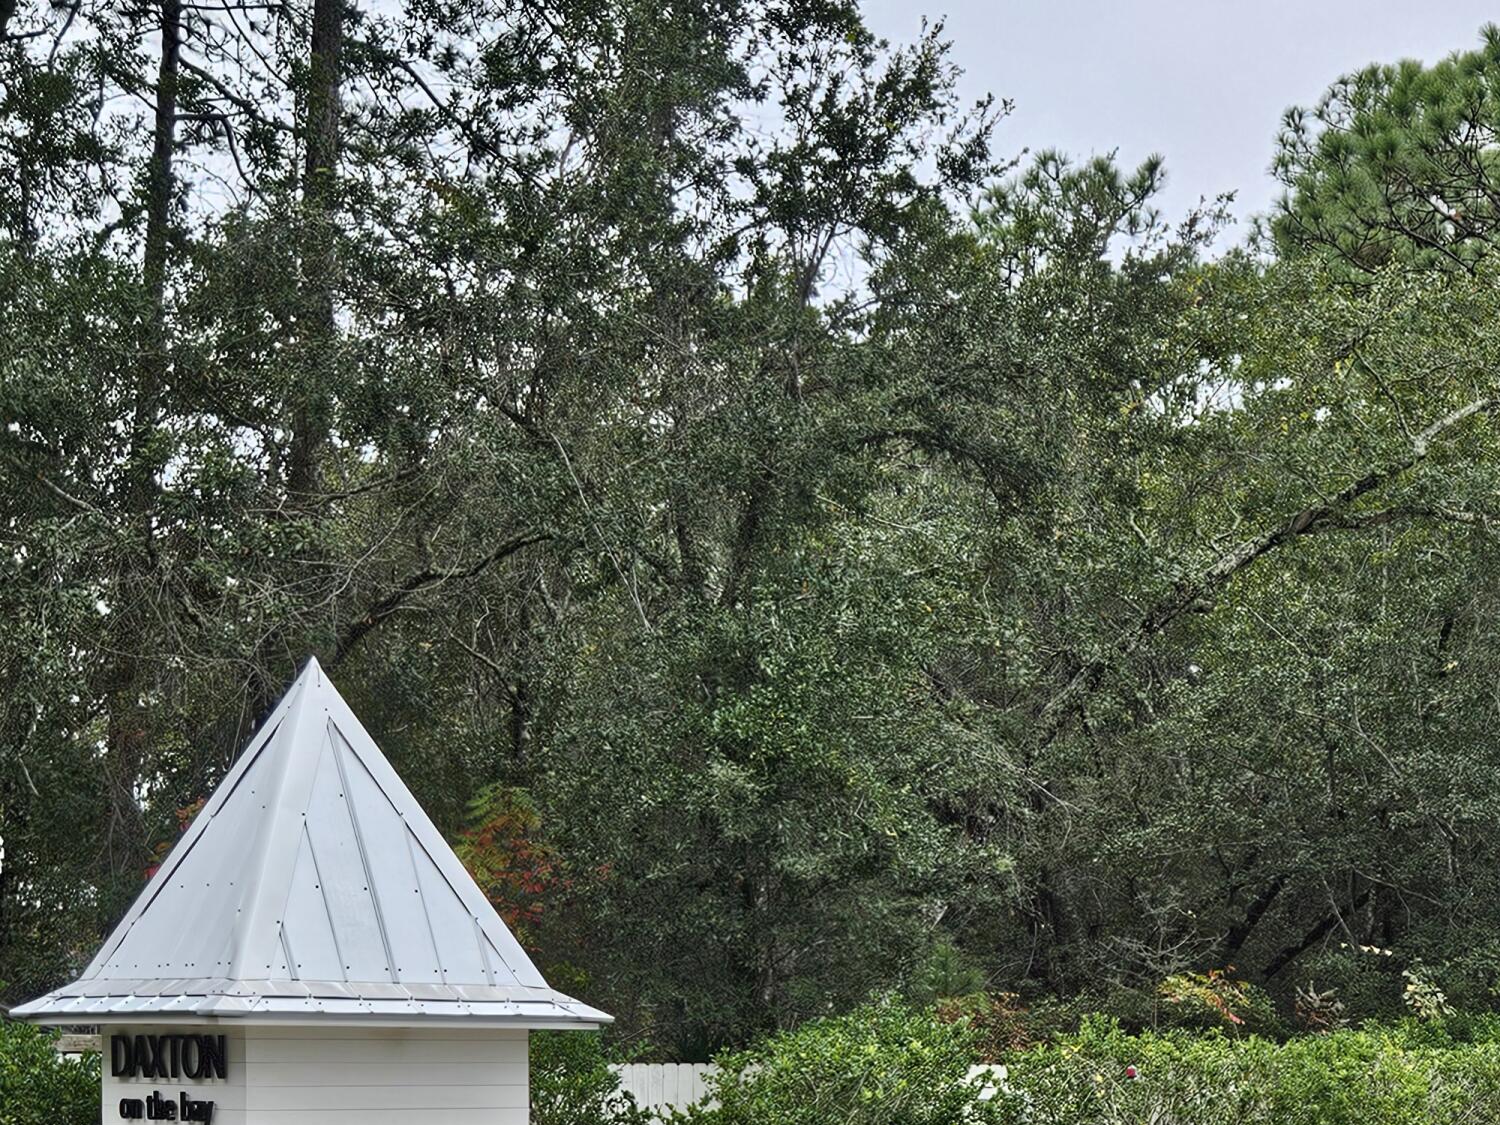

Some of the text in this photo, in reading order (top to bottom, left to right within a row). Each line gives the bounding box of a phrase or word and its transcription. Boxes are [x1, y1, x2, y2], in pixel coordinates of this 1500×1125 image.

[110, 1034, 227, 1079] DAXTON
[119, 1098, 144, 1119] on
[146, 1090, 177, 1121] the
